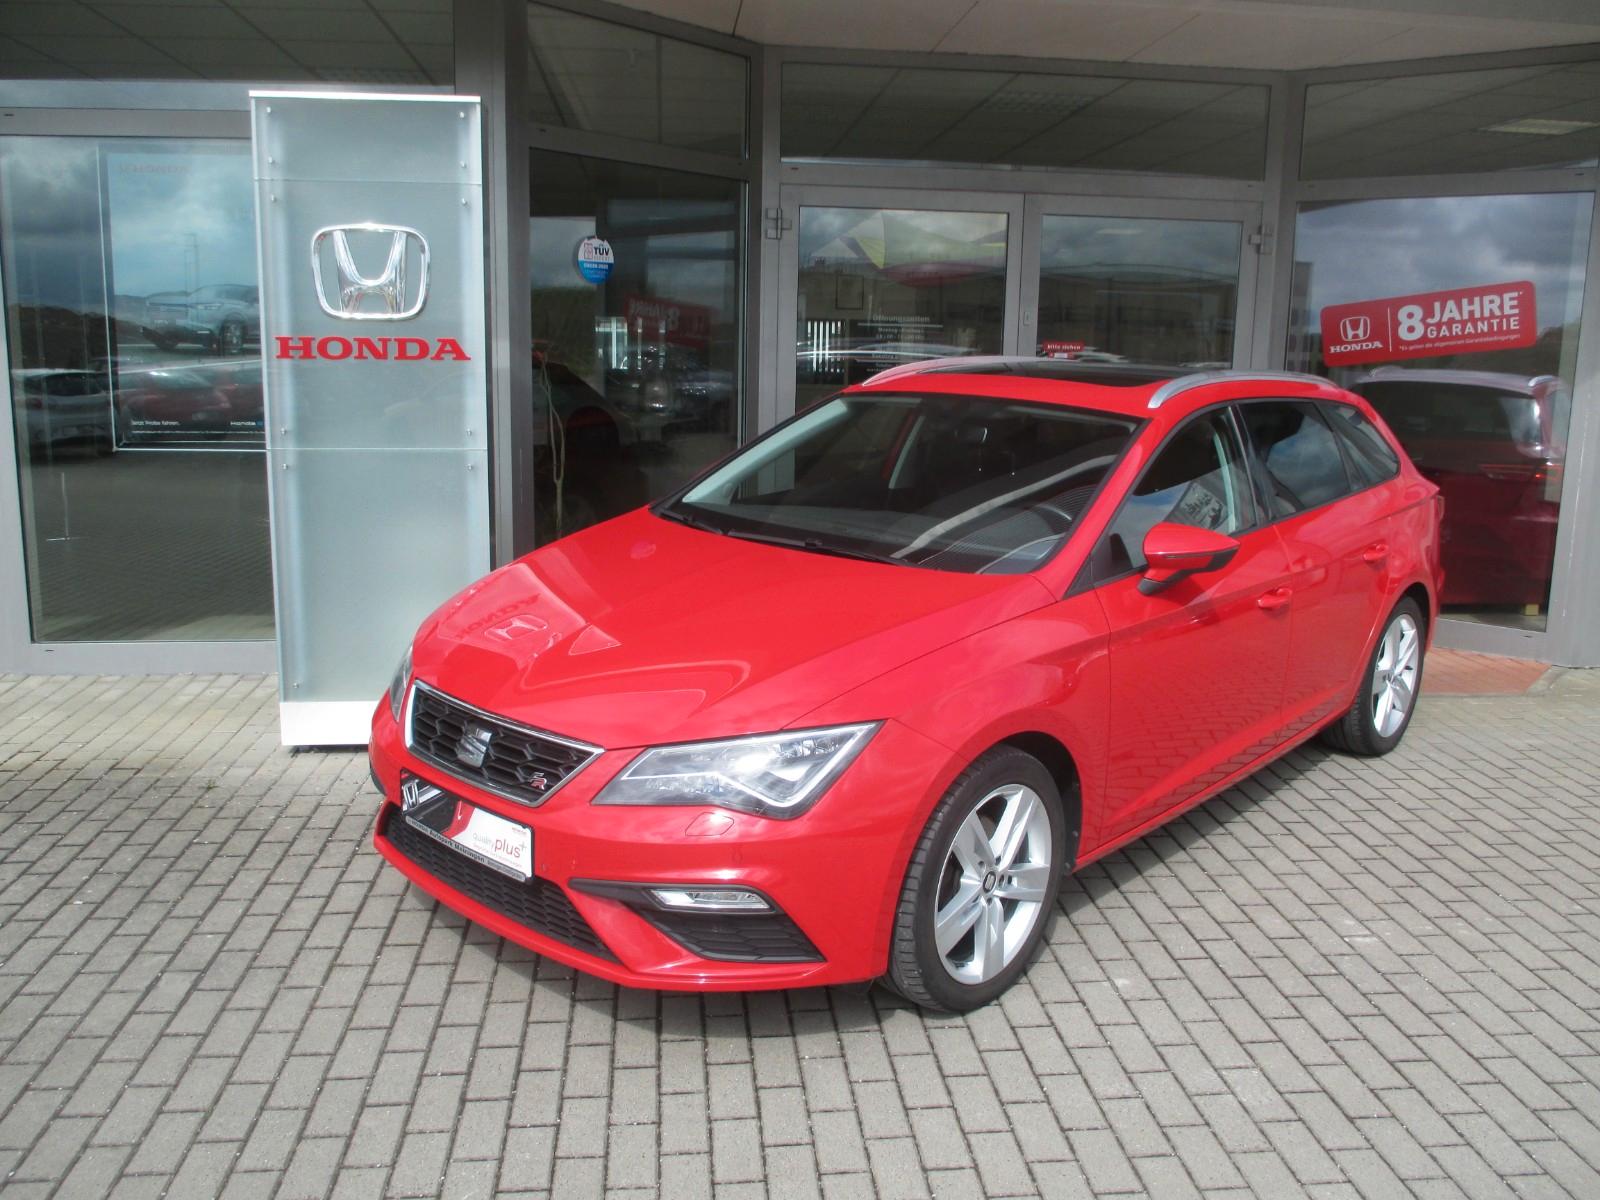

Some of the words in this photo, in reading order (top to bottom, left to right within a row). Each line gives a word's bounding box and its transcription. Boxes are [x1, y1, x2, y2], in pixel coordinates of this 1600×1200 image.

[1397, 304, 1425, 341] 8
[1427, 317, 1520, 338] GARANTIE
[275, 336, 471, 360] HONDA
[1329, 340, 1384, 354] HONDA
